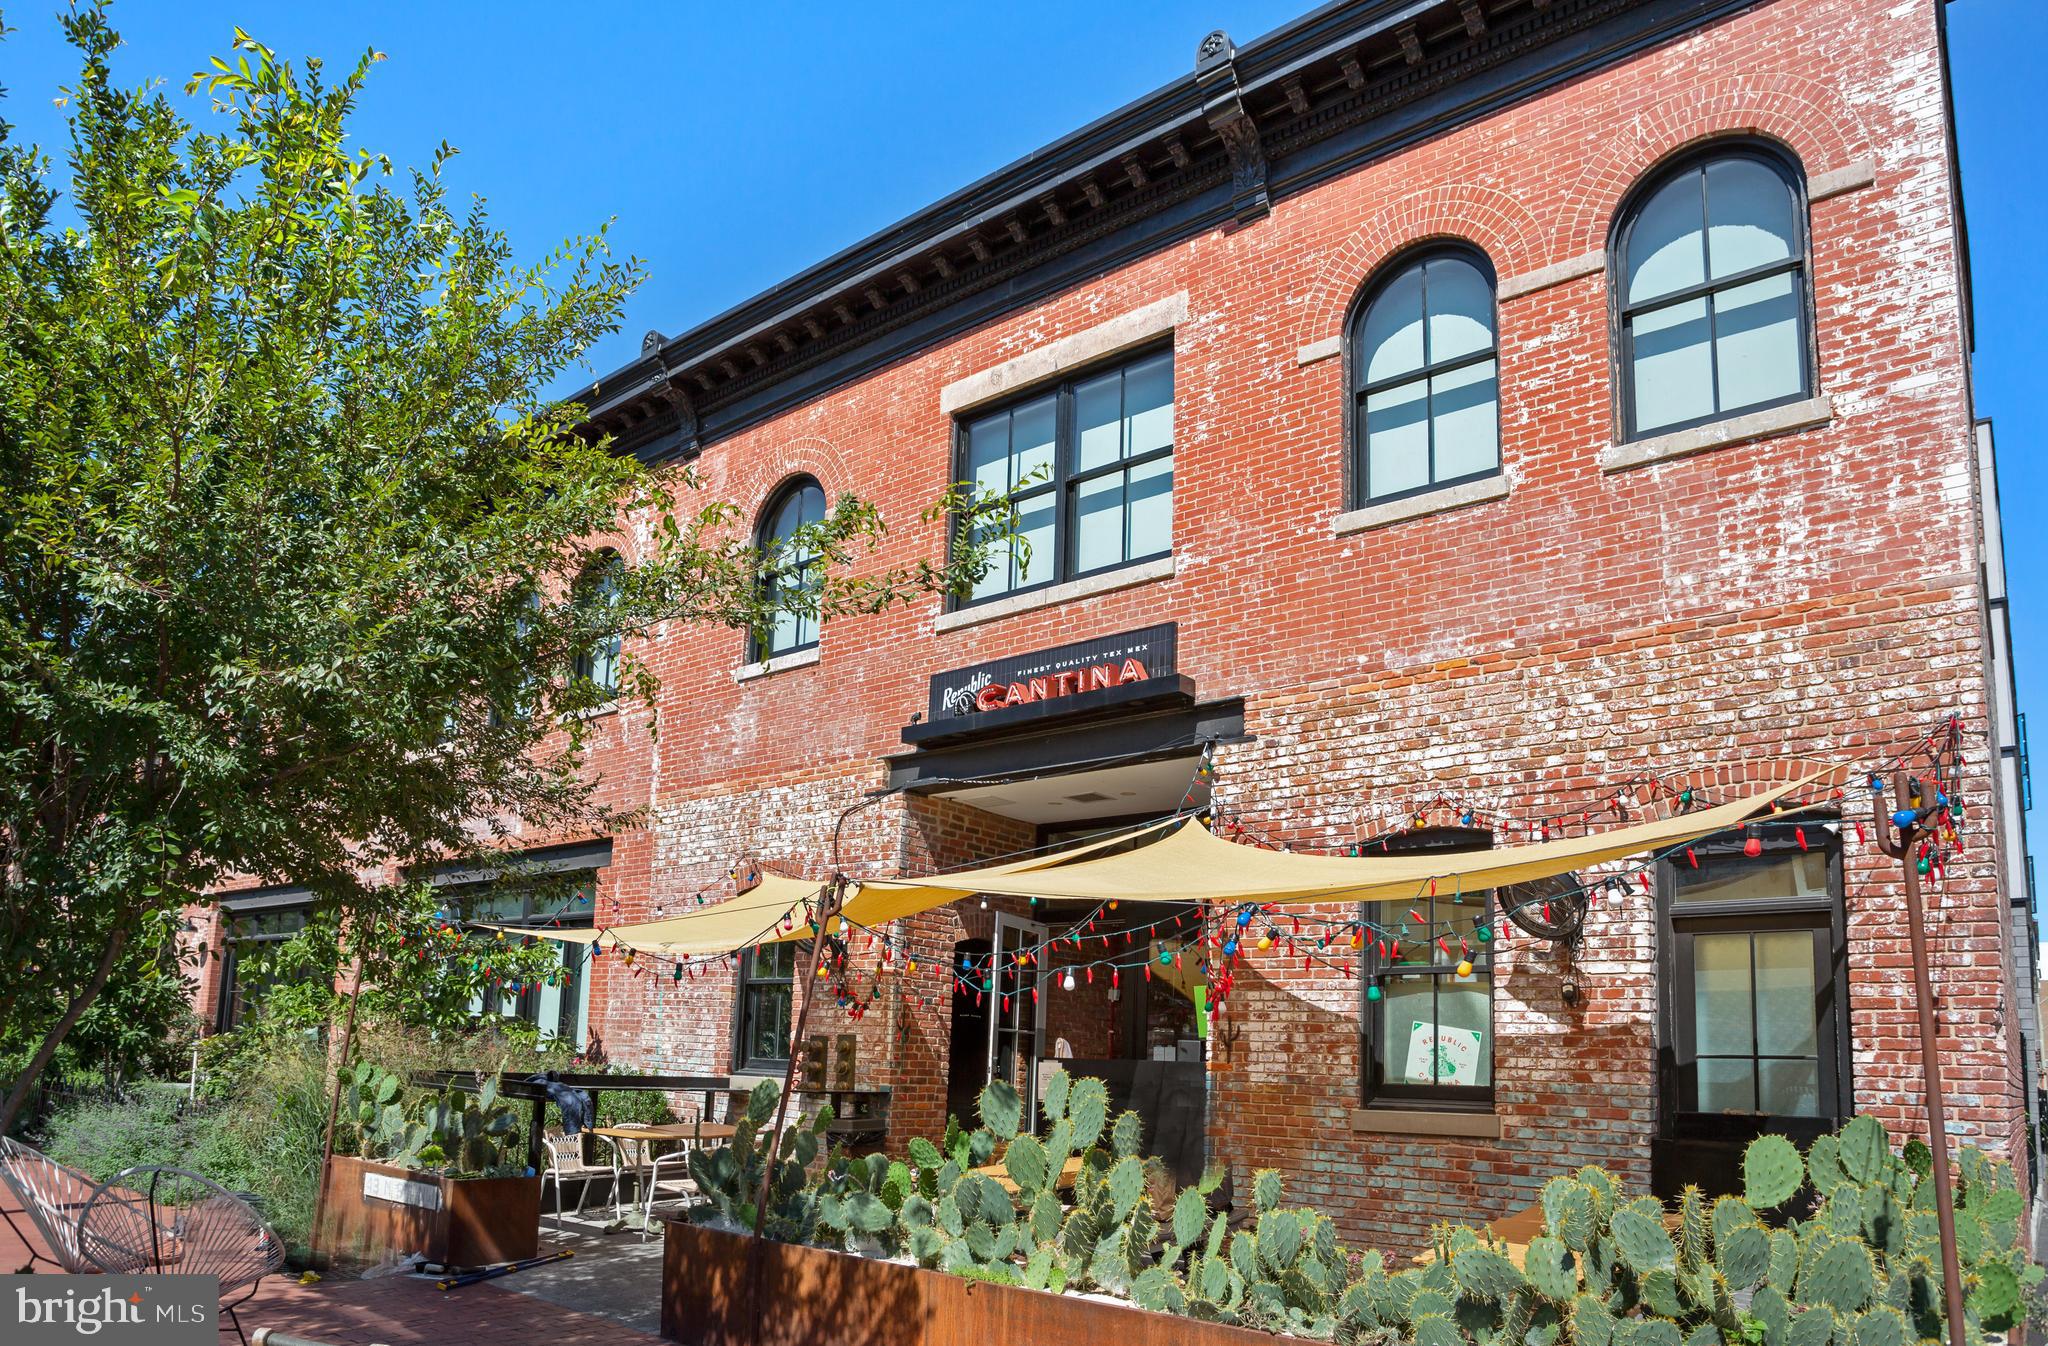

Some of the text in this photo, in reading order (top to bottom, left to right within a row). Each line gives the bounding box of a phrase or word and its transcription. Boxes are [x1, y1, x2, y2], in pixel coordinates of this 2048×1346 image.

[1017, 644, 1148, 677] FINEST QUALITY TEX MEX
[976, 657, 1148, 711] CANTINA
[1422, 1035, 1467, 1052] REUBLIC
